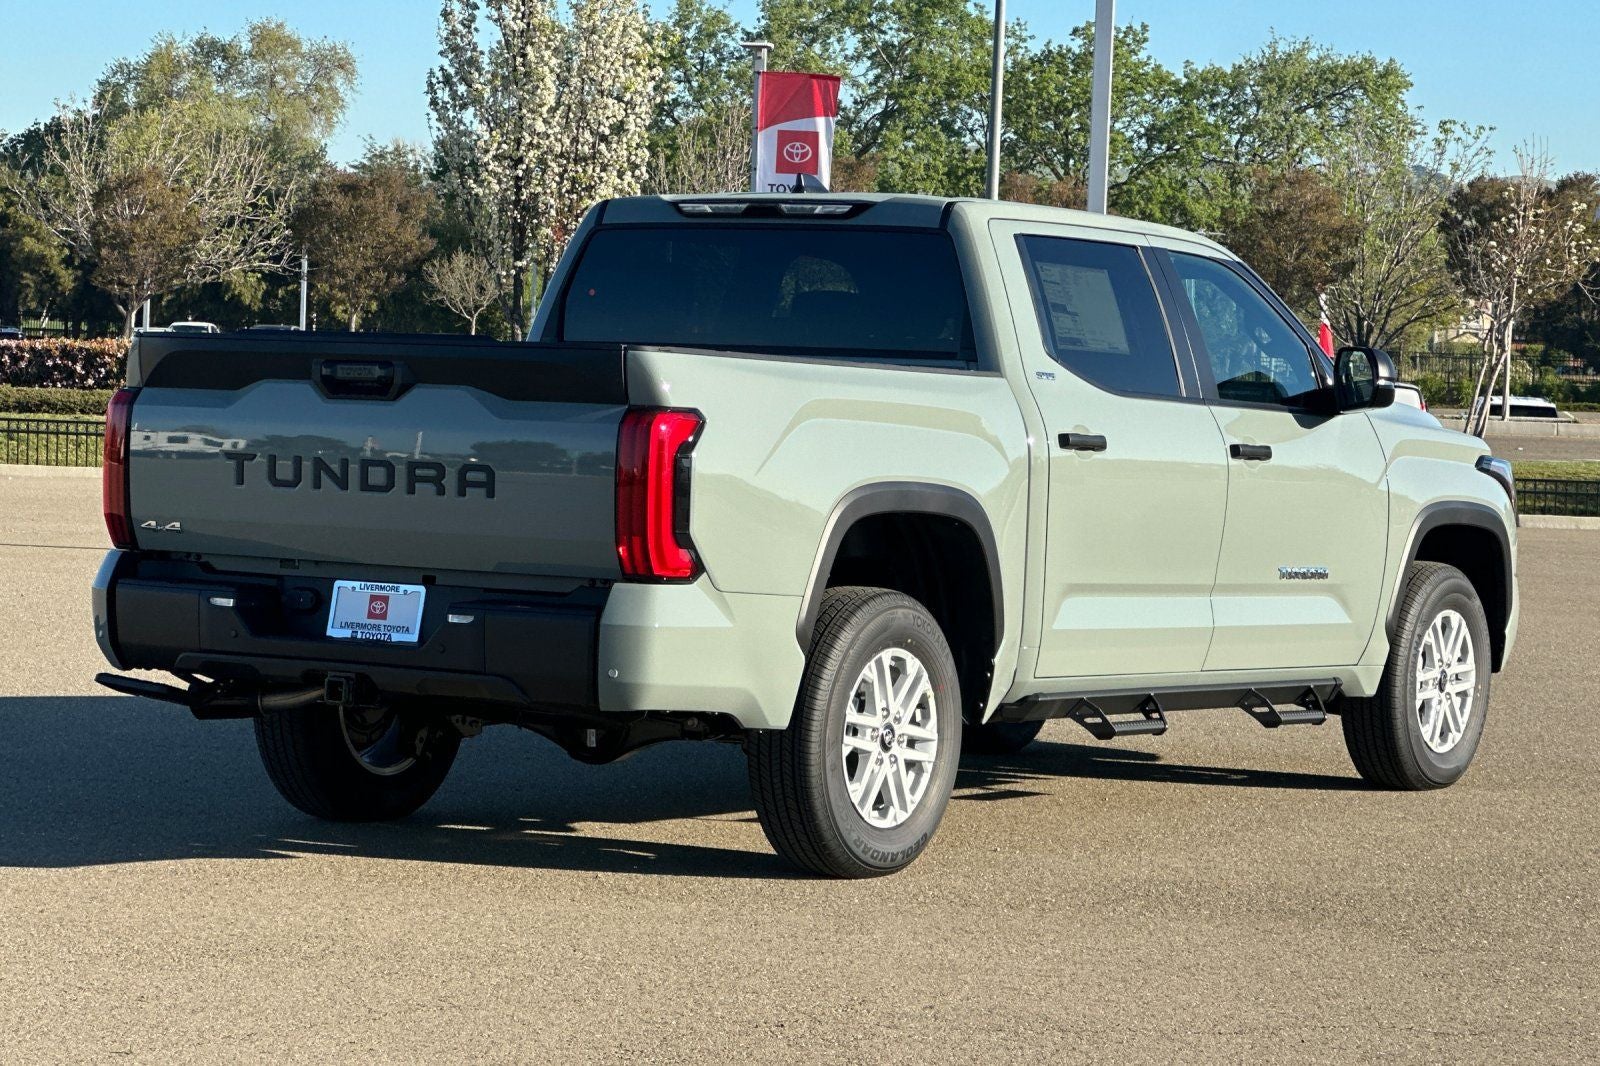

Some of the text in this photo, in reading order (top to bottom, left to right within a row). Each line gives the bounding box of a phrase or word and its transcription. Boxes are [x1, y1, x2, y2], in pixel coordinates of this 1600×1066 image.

[340, 366, 374, 376] TOYOTA
[224, 450, 496, 499] TUNDRA
[359, 583, 401, 593] LIVERMORE
[340, 621, 409, 633] LIVERMORE TOYOTA
[360, 631, 392, 641] TOYOTA
[912, 612, 949, 661] YOKOHAMA
[853, 831, 928, 863] GEOLANDAR
